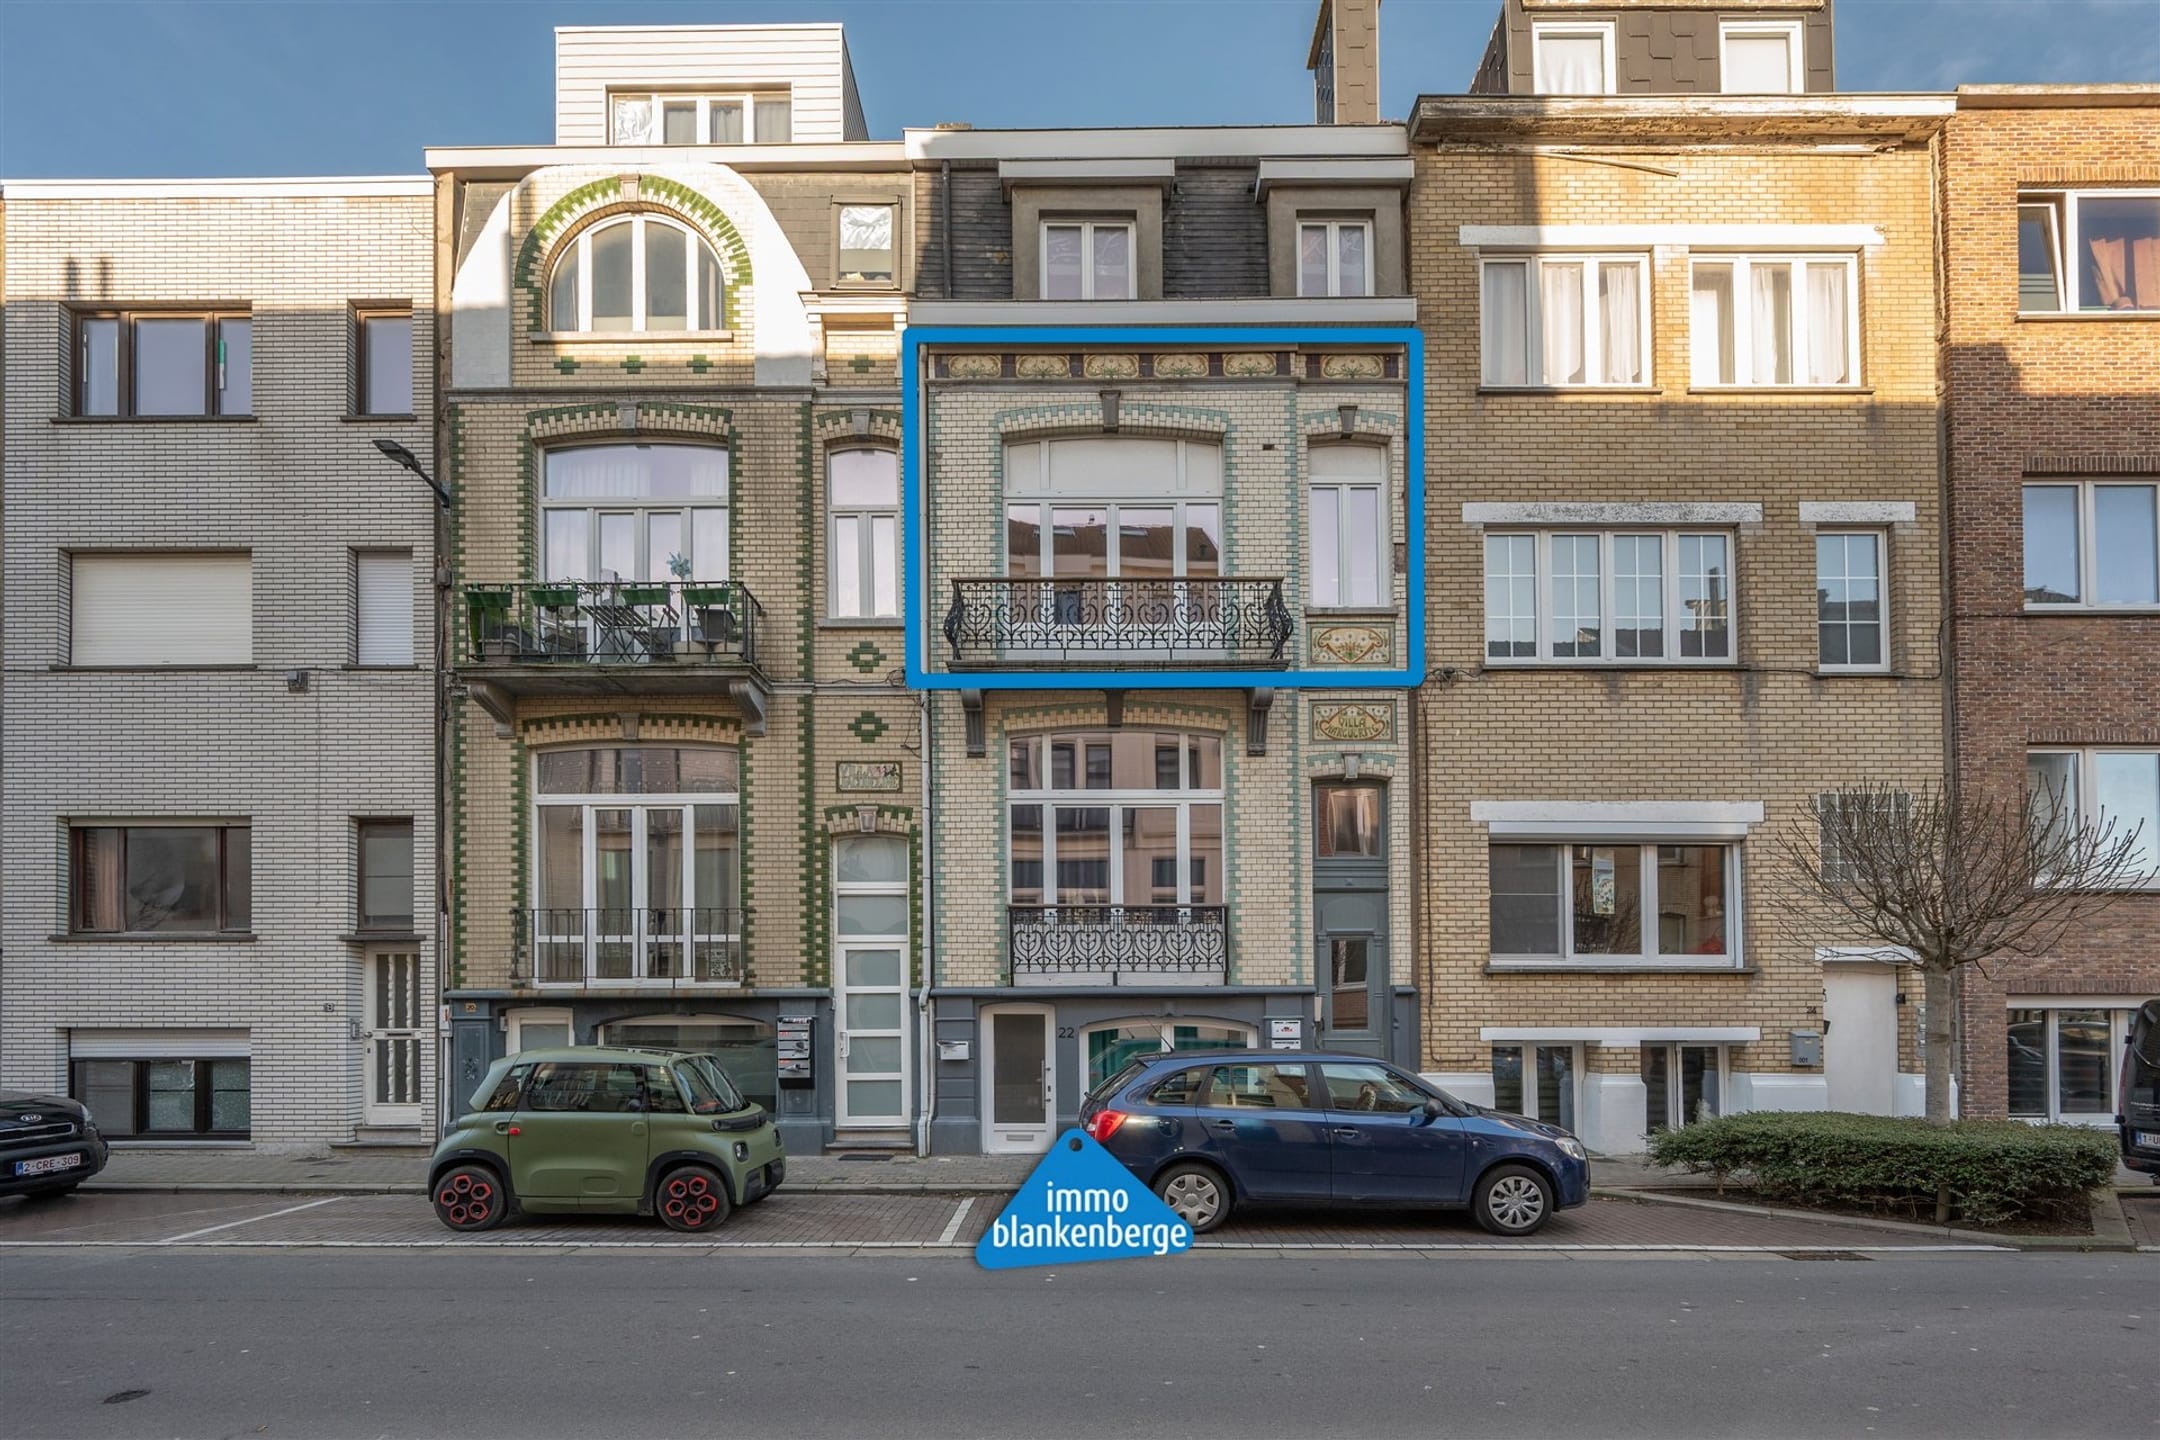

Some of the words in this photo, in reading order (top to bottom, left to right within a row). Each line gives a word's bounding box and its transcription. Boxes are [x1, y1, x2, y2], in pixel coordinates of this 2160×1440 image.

[1339, 717, 1366, 728] VILLA
[1058, 1026, 1075, 1039] 22
[23, 1155, 79, 1173] 2-CRE-309
